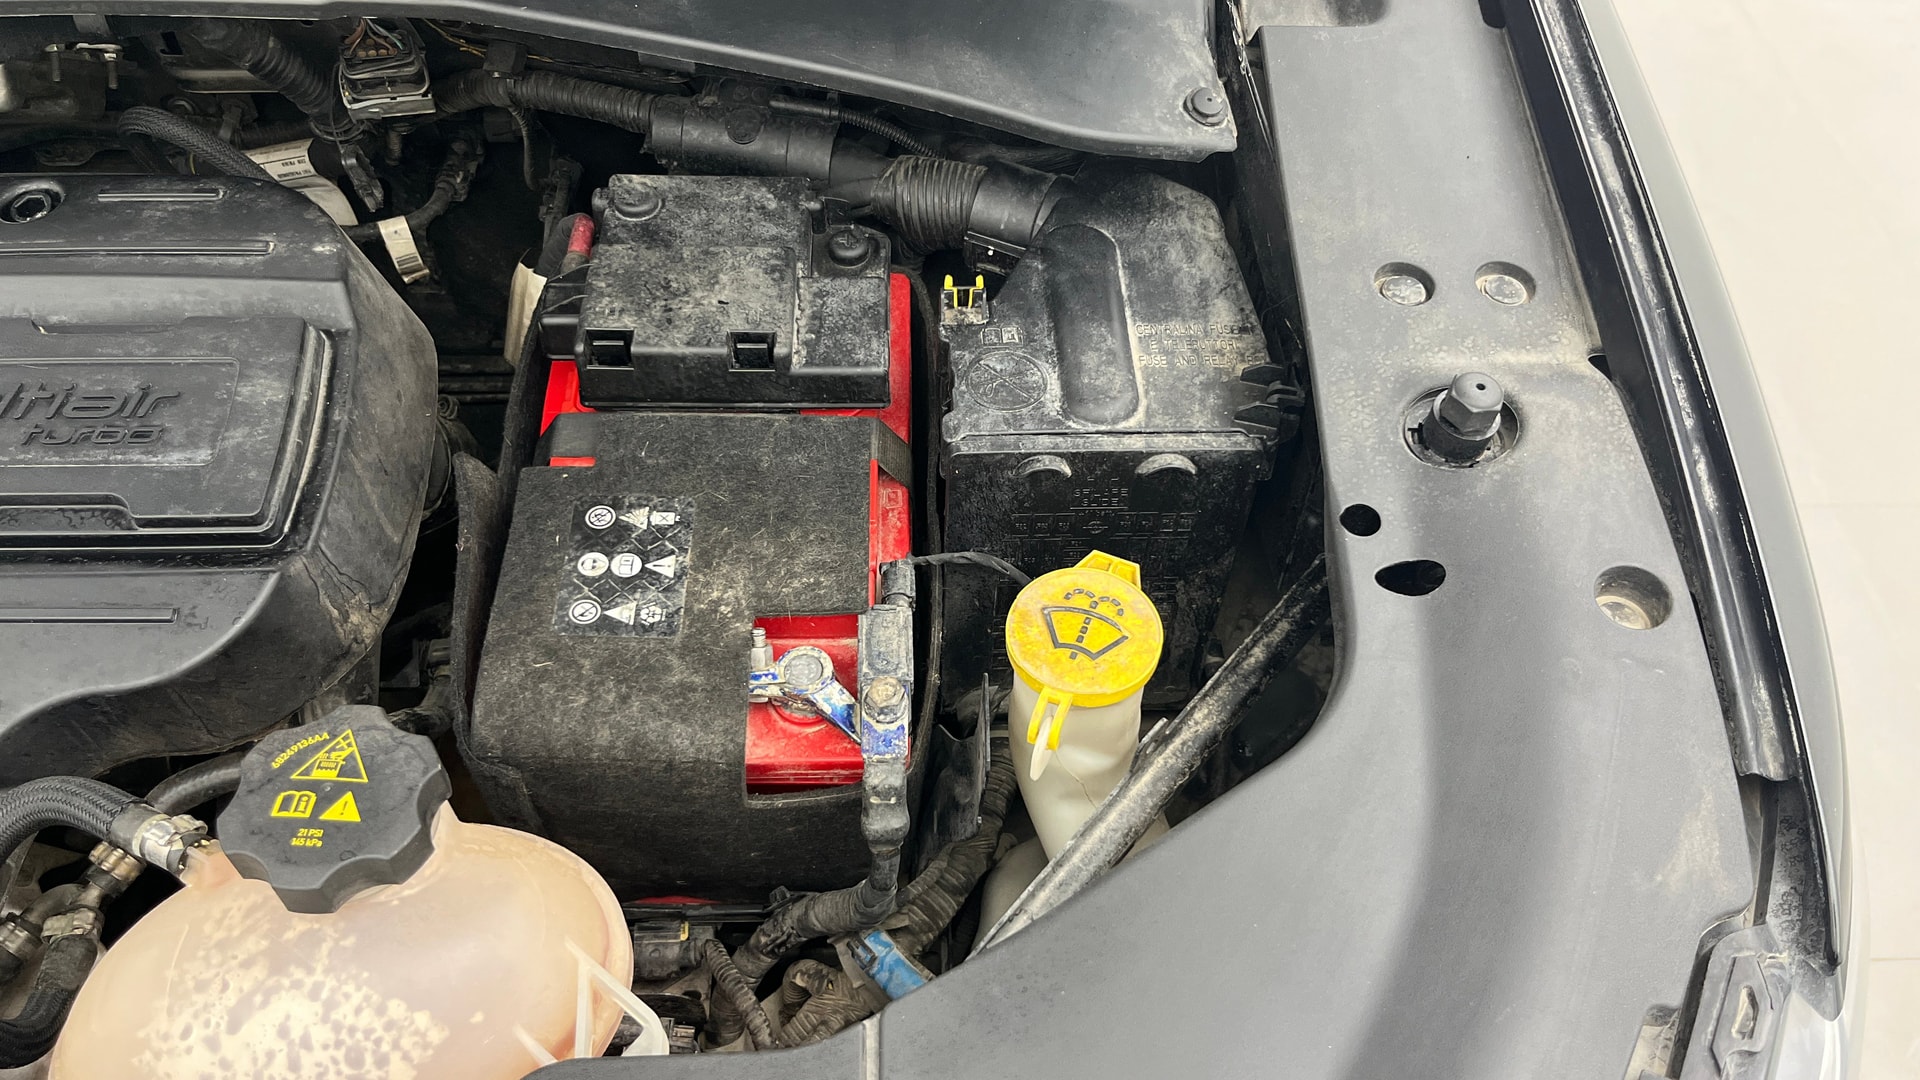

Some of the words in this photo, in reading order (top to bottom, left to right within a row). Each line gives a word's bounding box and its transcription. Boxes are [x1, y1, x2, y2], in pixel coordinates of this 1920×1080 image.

[1135, 324, 1204, 335] CENTRALINA
[1150, 340, 1158, 351] E
[1139, 355, 1168, 367] FUSE
[1175, 355, 1197, 366] AND
[1204, 355, 1239, 366] RELAY
[21, 423, 164, 446] turbo
[271, 732, 330, 769] 68249136AA
[297, 828, 308, 837] 21
[308, 828, 324, 838] PSI
[305, 838, 323, 848] kPa
